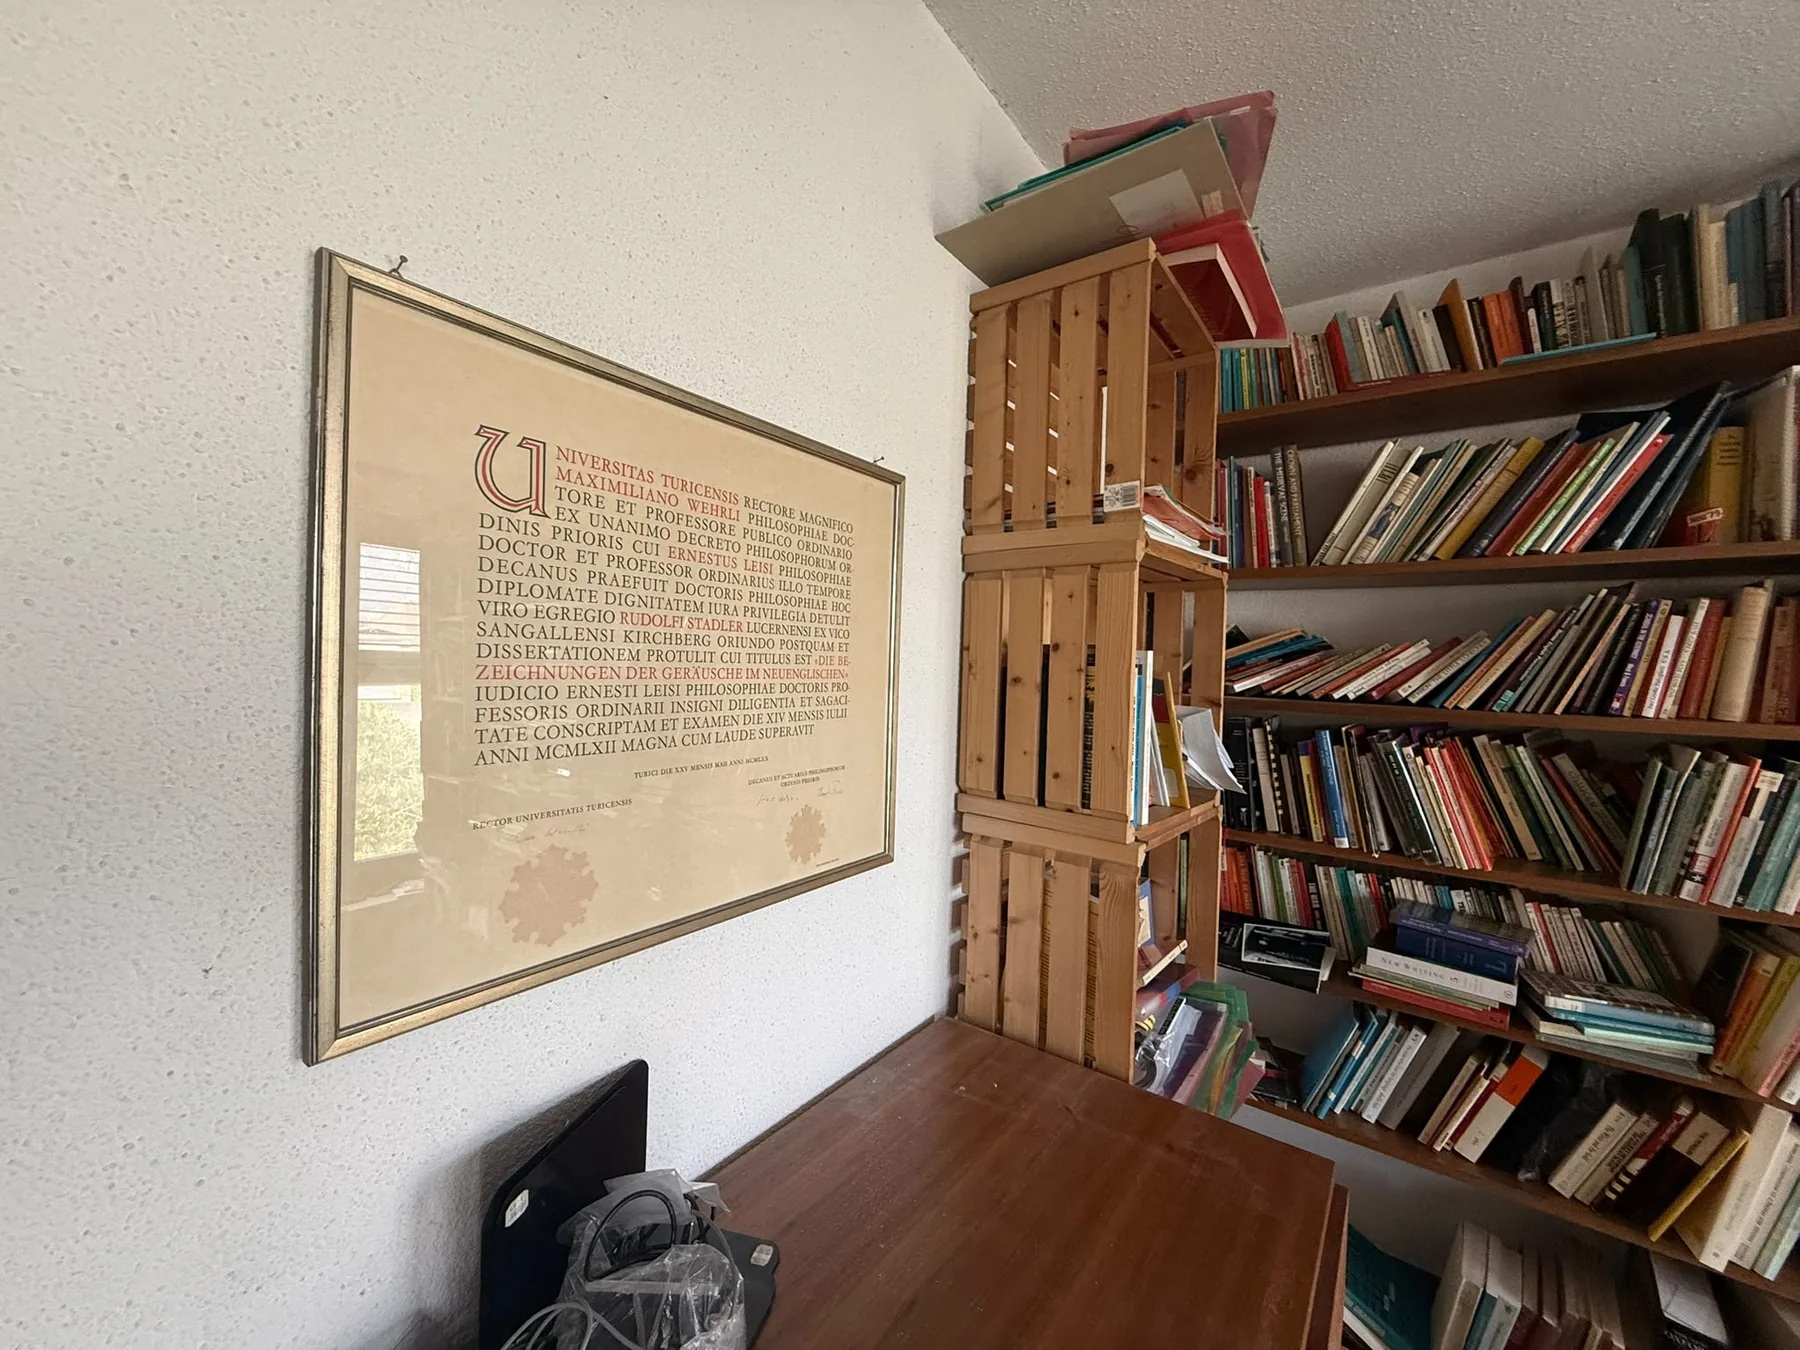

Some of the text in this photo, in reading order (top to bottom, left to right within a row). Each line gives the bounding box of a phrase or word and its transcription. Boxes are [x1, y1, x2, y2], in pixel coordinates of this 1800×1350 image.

[554, 485, 853, 560] TORE ET PROFESSORE PUBLICO ORDINARIO
[555, 465, 856, 547] MAXIMILIANO WEHRLI PHILOSOPHIAE DOC-
[660, 473, 740, 505] TURICENSIS
[743, 495, 795, 520] RECTORE
[798, 510, 854, 534] MAGNIFICO
[479, 512, 852, 587] DINIS PRIORIS CUI ERNESTUS LEISI PHILOSOPHIAE
[554, 506, 580, 524] EX
[589, 513, 671, 541] UNANIMO
[677, 529, 741, 553] DECRETO
[745, 544, 837, 570] PHILOSOPHORUM
[478, 534, 852, 600] DOCTOR ET PROFESSOR ORDINARIUS ILLO TEMPORE
[478, 556, 851, 614] DECANUS PRAEFUIT DOCTORIS PHILOSOPHIAE HOC
[477, 577, 851, 627] DIPLOMATE DIGNITATEM IURA PRIVILEGIA DETULIT
[478, 599, 850, 640] VIRO EGREGIO RUDOLFI STADLER LUCERNENSI EX VICO
[476, 621, 850, 655] SANGALLENSI KIRCHBERG ORIUNDO POSTQUAM ET
[476, 642, 641, 662] DISSERTATIONEM
[647, 648, 716, 664] PROTULIT
[720, 651, 741, 664] CUI
[745, 652, 791, 665] TITULUS
[794, 654, 812, 665] EST
[475, 664, 622, 681] ZEICHNUNGEN
[625, 666, 658, 680] DER
[661, 664, 742, 680] GERÄUSCHE
[745, 668, 760, 680] IM
[475, 681, 851, 702] IUDICIO ERNESTI LEISI PHILOSOPHIAE DOCTORIS PRO-
[474, 708, 848, 745] TATE CONSCRIPTAM ET EXAMEN DIE XIV MENSIS IULII
[475, 694, 851, 723] FESSORIS ORDINARII INSIGNI DILIGENTIA ET SAGACI-
[473, 723, 816, 767] ANNI MCMLXII MAGNA CUM LAUDE SUPERAVIT
[633, 769, 659, 779] TURICI
[660, 767, 674, 776] DIE
[674, 766, 690, 774] XXV
[690, 762, 713, 772] MENSIS
[472, 798, 633, 831] RECTOR UNIVERSITATIS TURICENSIS
